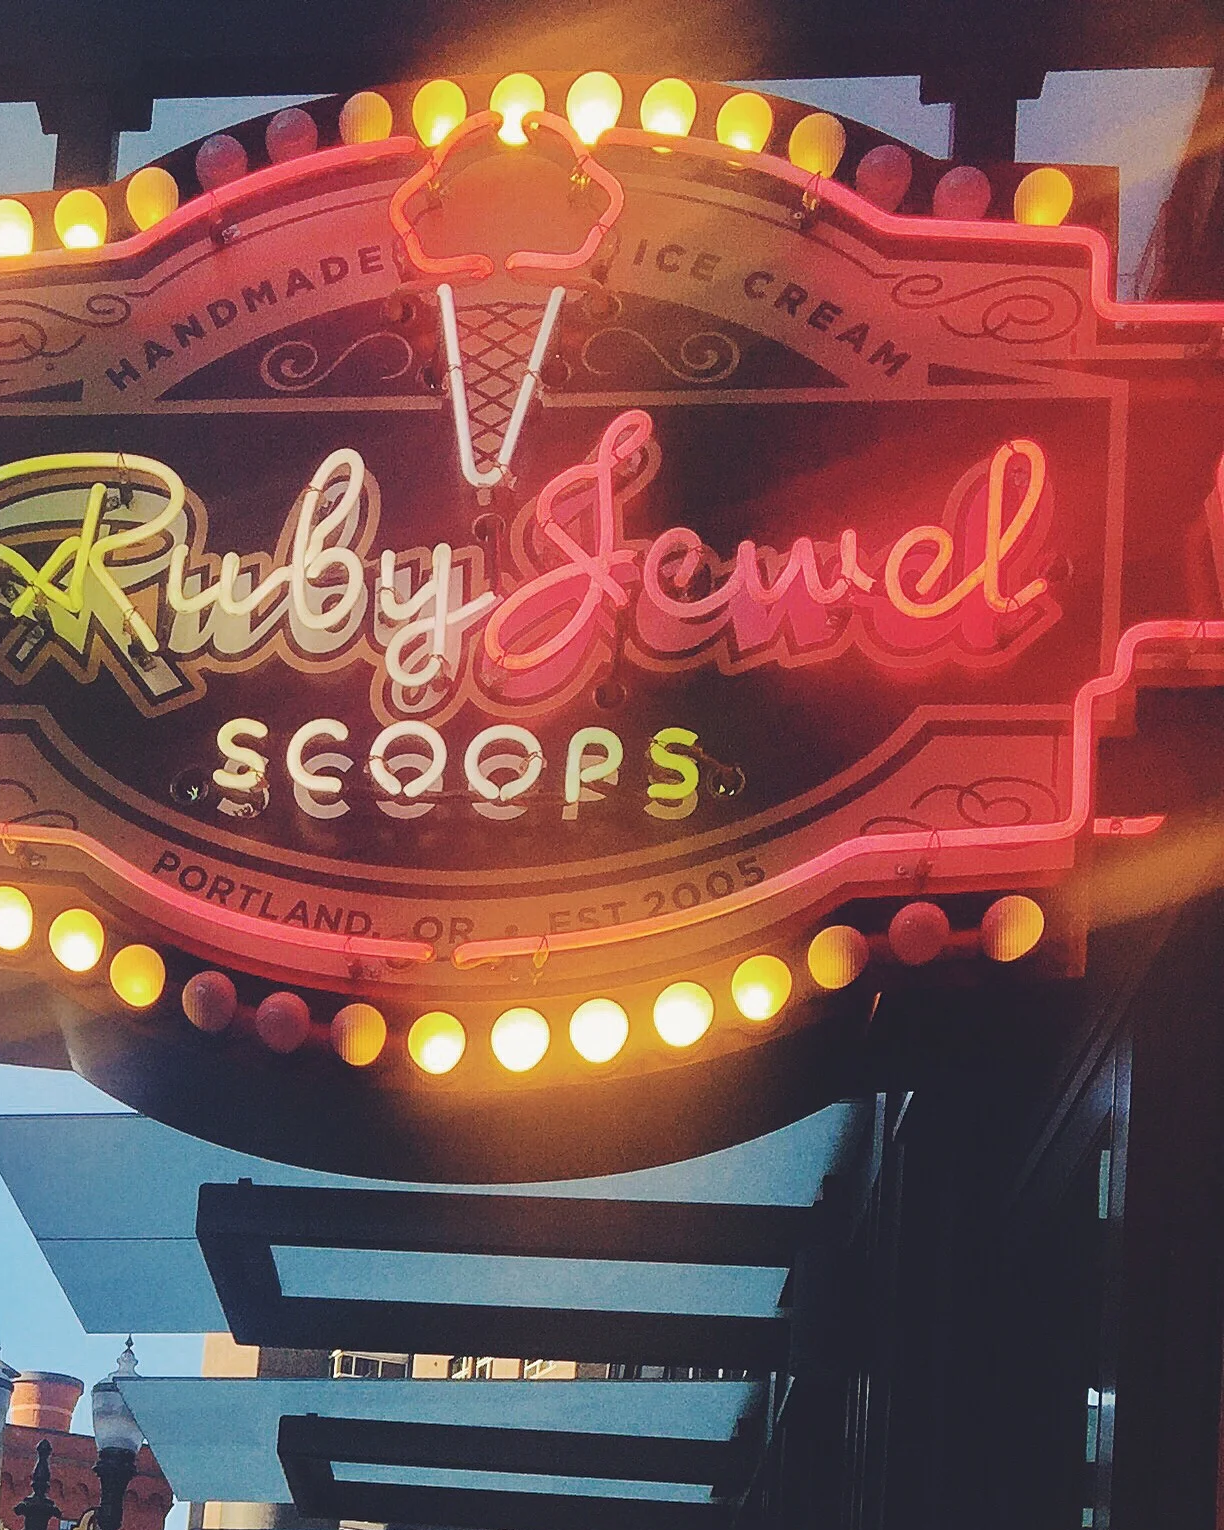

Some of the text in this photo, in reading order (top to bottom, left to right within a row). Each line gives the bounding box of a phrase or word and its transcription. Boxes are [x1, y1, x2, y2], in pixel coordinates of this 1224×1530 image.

[104, 245, 385, 391] HANDMADE
[632, 238, 912, 378] ICE CREAM
[482, 410, 1048, 671] Jewel
[212, 717, 700, 815] SCOOPS
[412, 915, 475, 945] OR
[548, 901, 628, 933] EST
[642, 856, 767, 918] 2005
